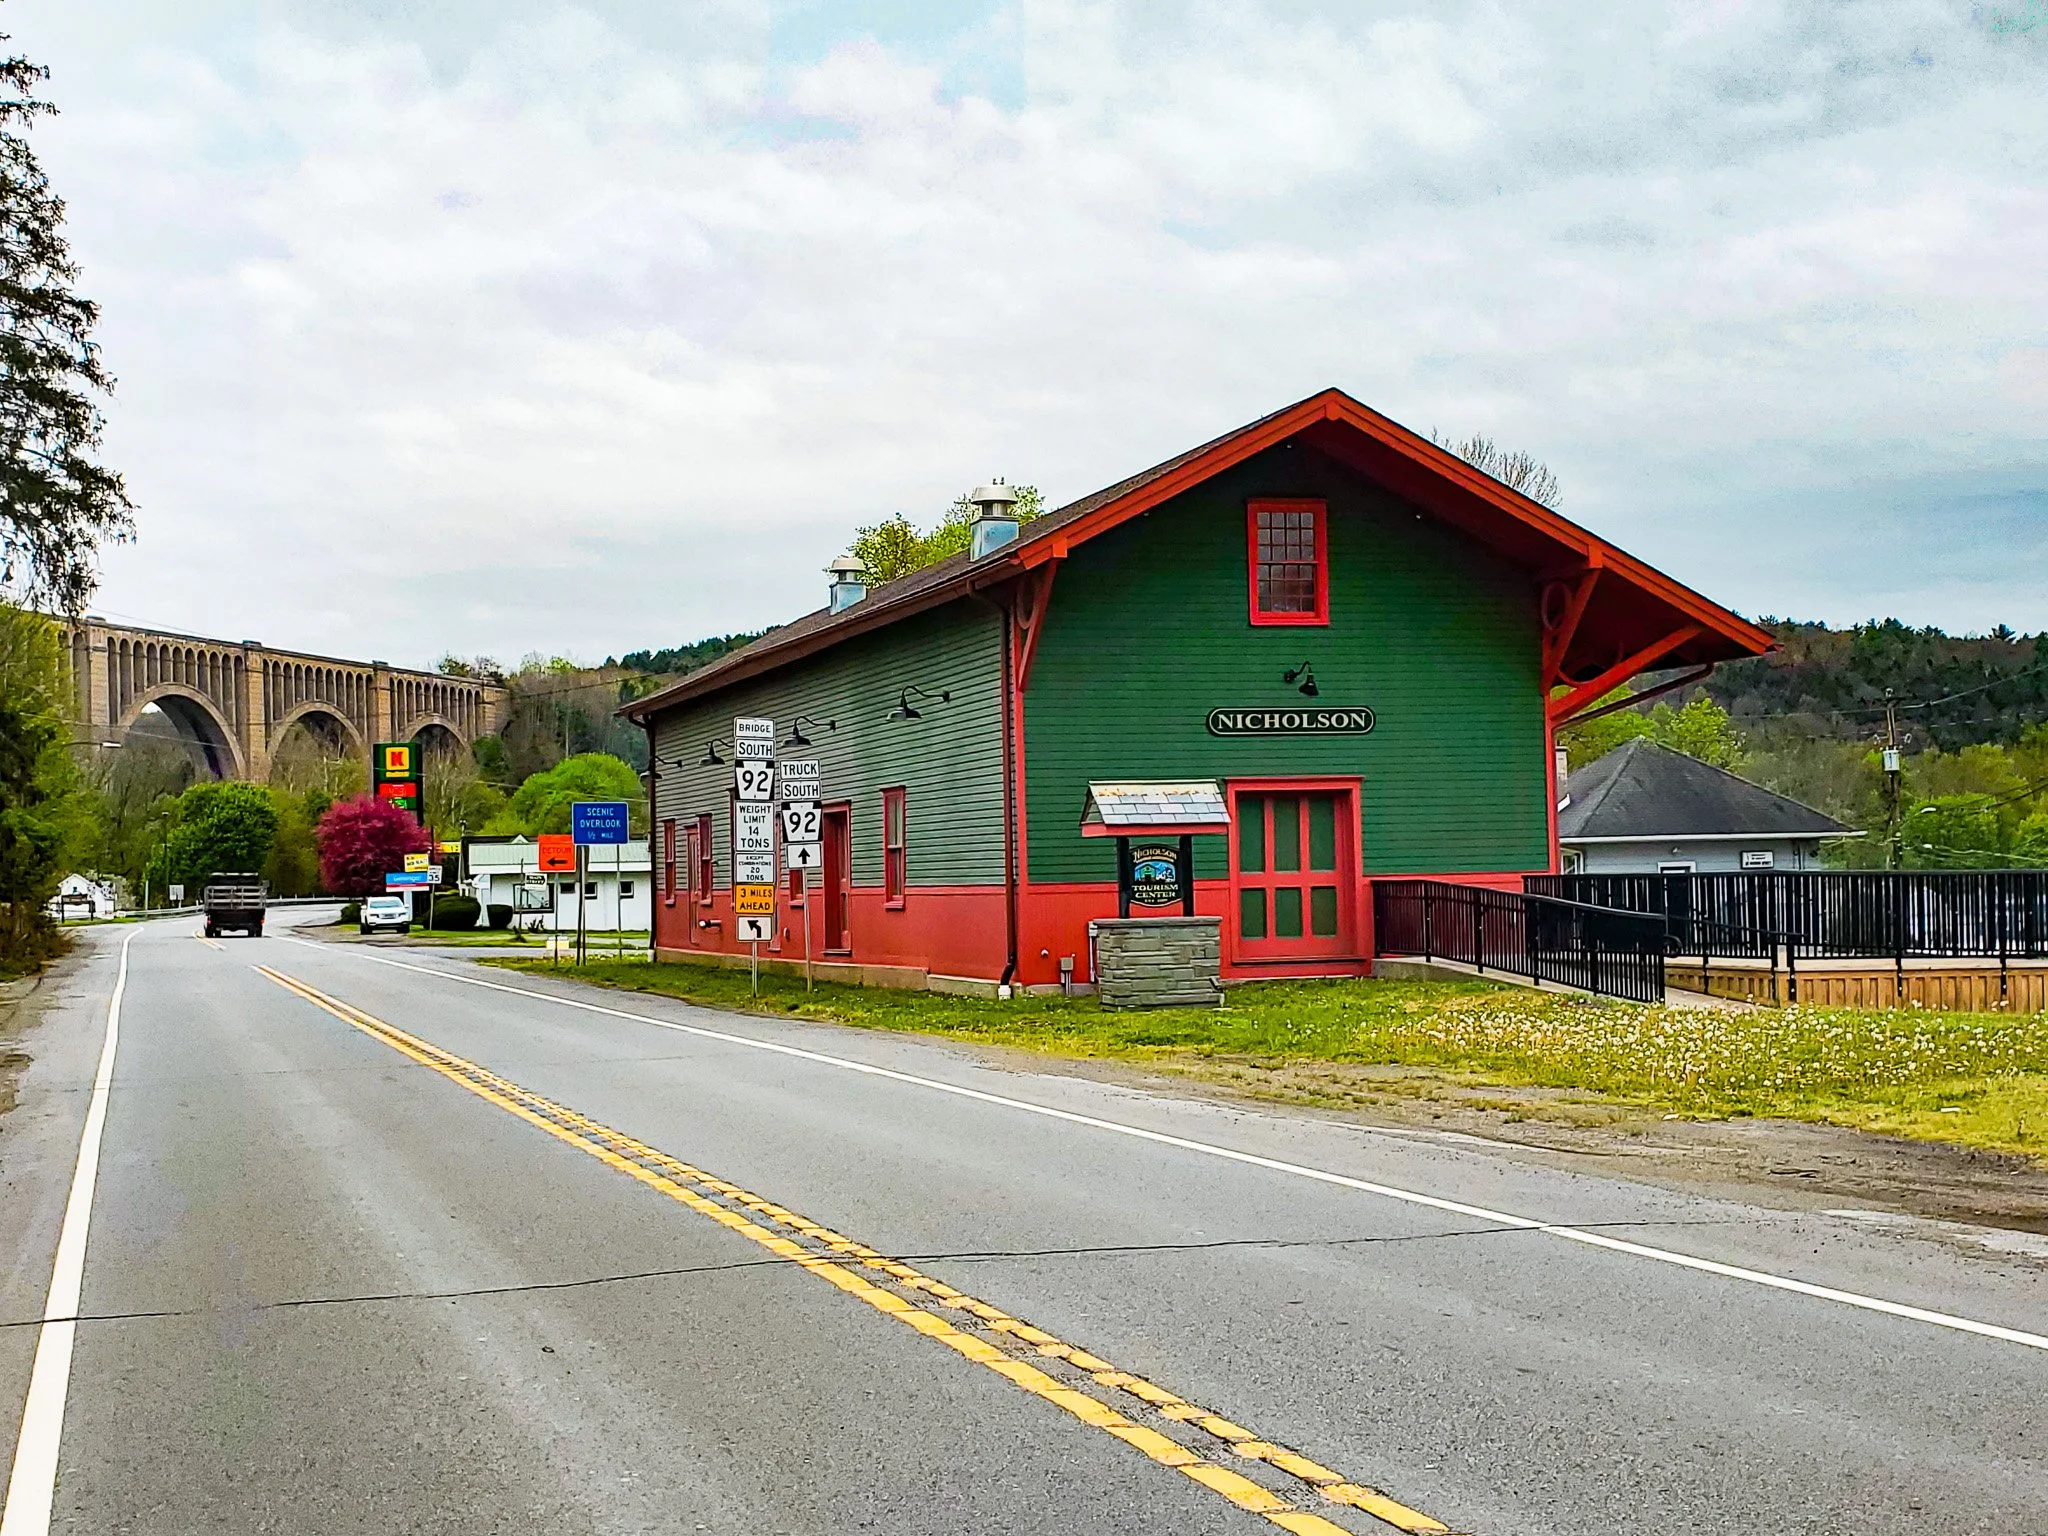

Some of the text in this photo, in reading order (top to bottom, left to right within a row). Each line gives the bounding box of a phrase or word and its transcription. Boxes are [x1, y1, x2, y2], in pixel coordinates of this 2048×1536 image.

[1217, 712, 1367, 729] NICHOLSON
[738, 723, 771, 733] BRIDGE
[738, 742, 773, 756] SOUTH
[782, 763, 817, 776] TRUCK
[742, 770, 768, 792] 92
[784, 784, 818, 797] SOUTH
[587, 807, 614, 816] SCENIC
[739, 805, 771, 814] WEIGHT
[580, 819, 621, 828] OVERLOOK
[743, 815, 766, 823] LIMIT
[789, 811, 816, 834] 92
[601, 831, 614, 839] MILE
[749, 826, 759, 836] 14
[741, 838, 769, 848] TONS
[542, 847, 572, 855] DETOUR
[740, 888, 773, 898] 3 MILES
[1135, 891, 1176, 899] CENTER
[740, 902, 771, 911] AHEAD
